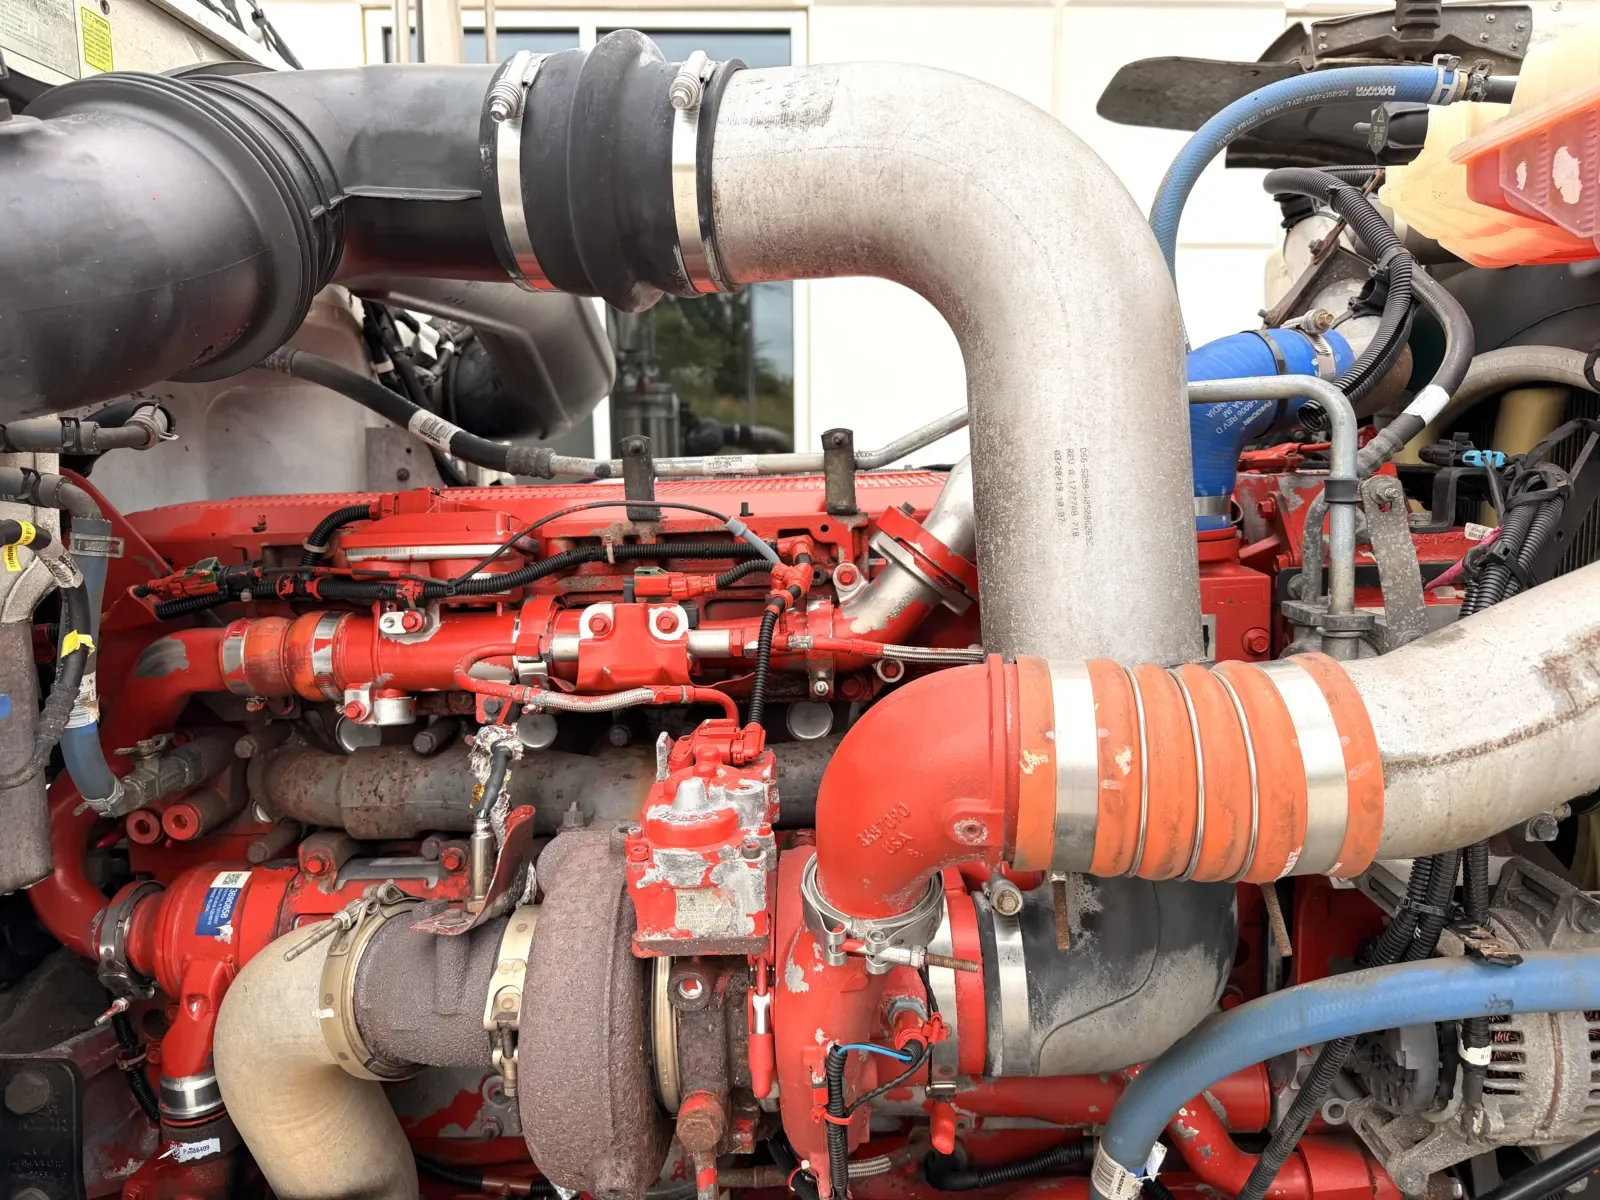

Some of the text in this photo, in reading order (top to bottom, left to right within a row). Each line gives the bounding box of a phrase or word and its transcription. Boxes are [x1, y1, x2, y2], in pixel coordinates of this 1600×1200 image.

[1222, 414, 1239, 430] REV
[1066, 448, 1075, 464] REV
[220, 888, 238, 919] 3690858
